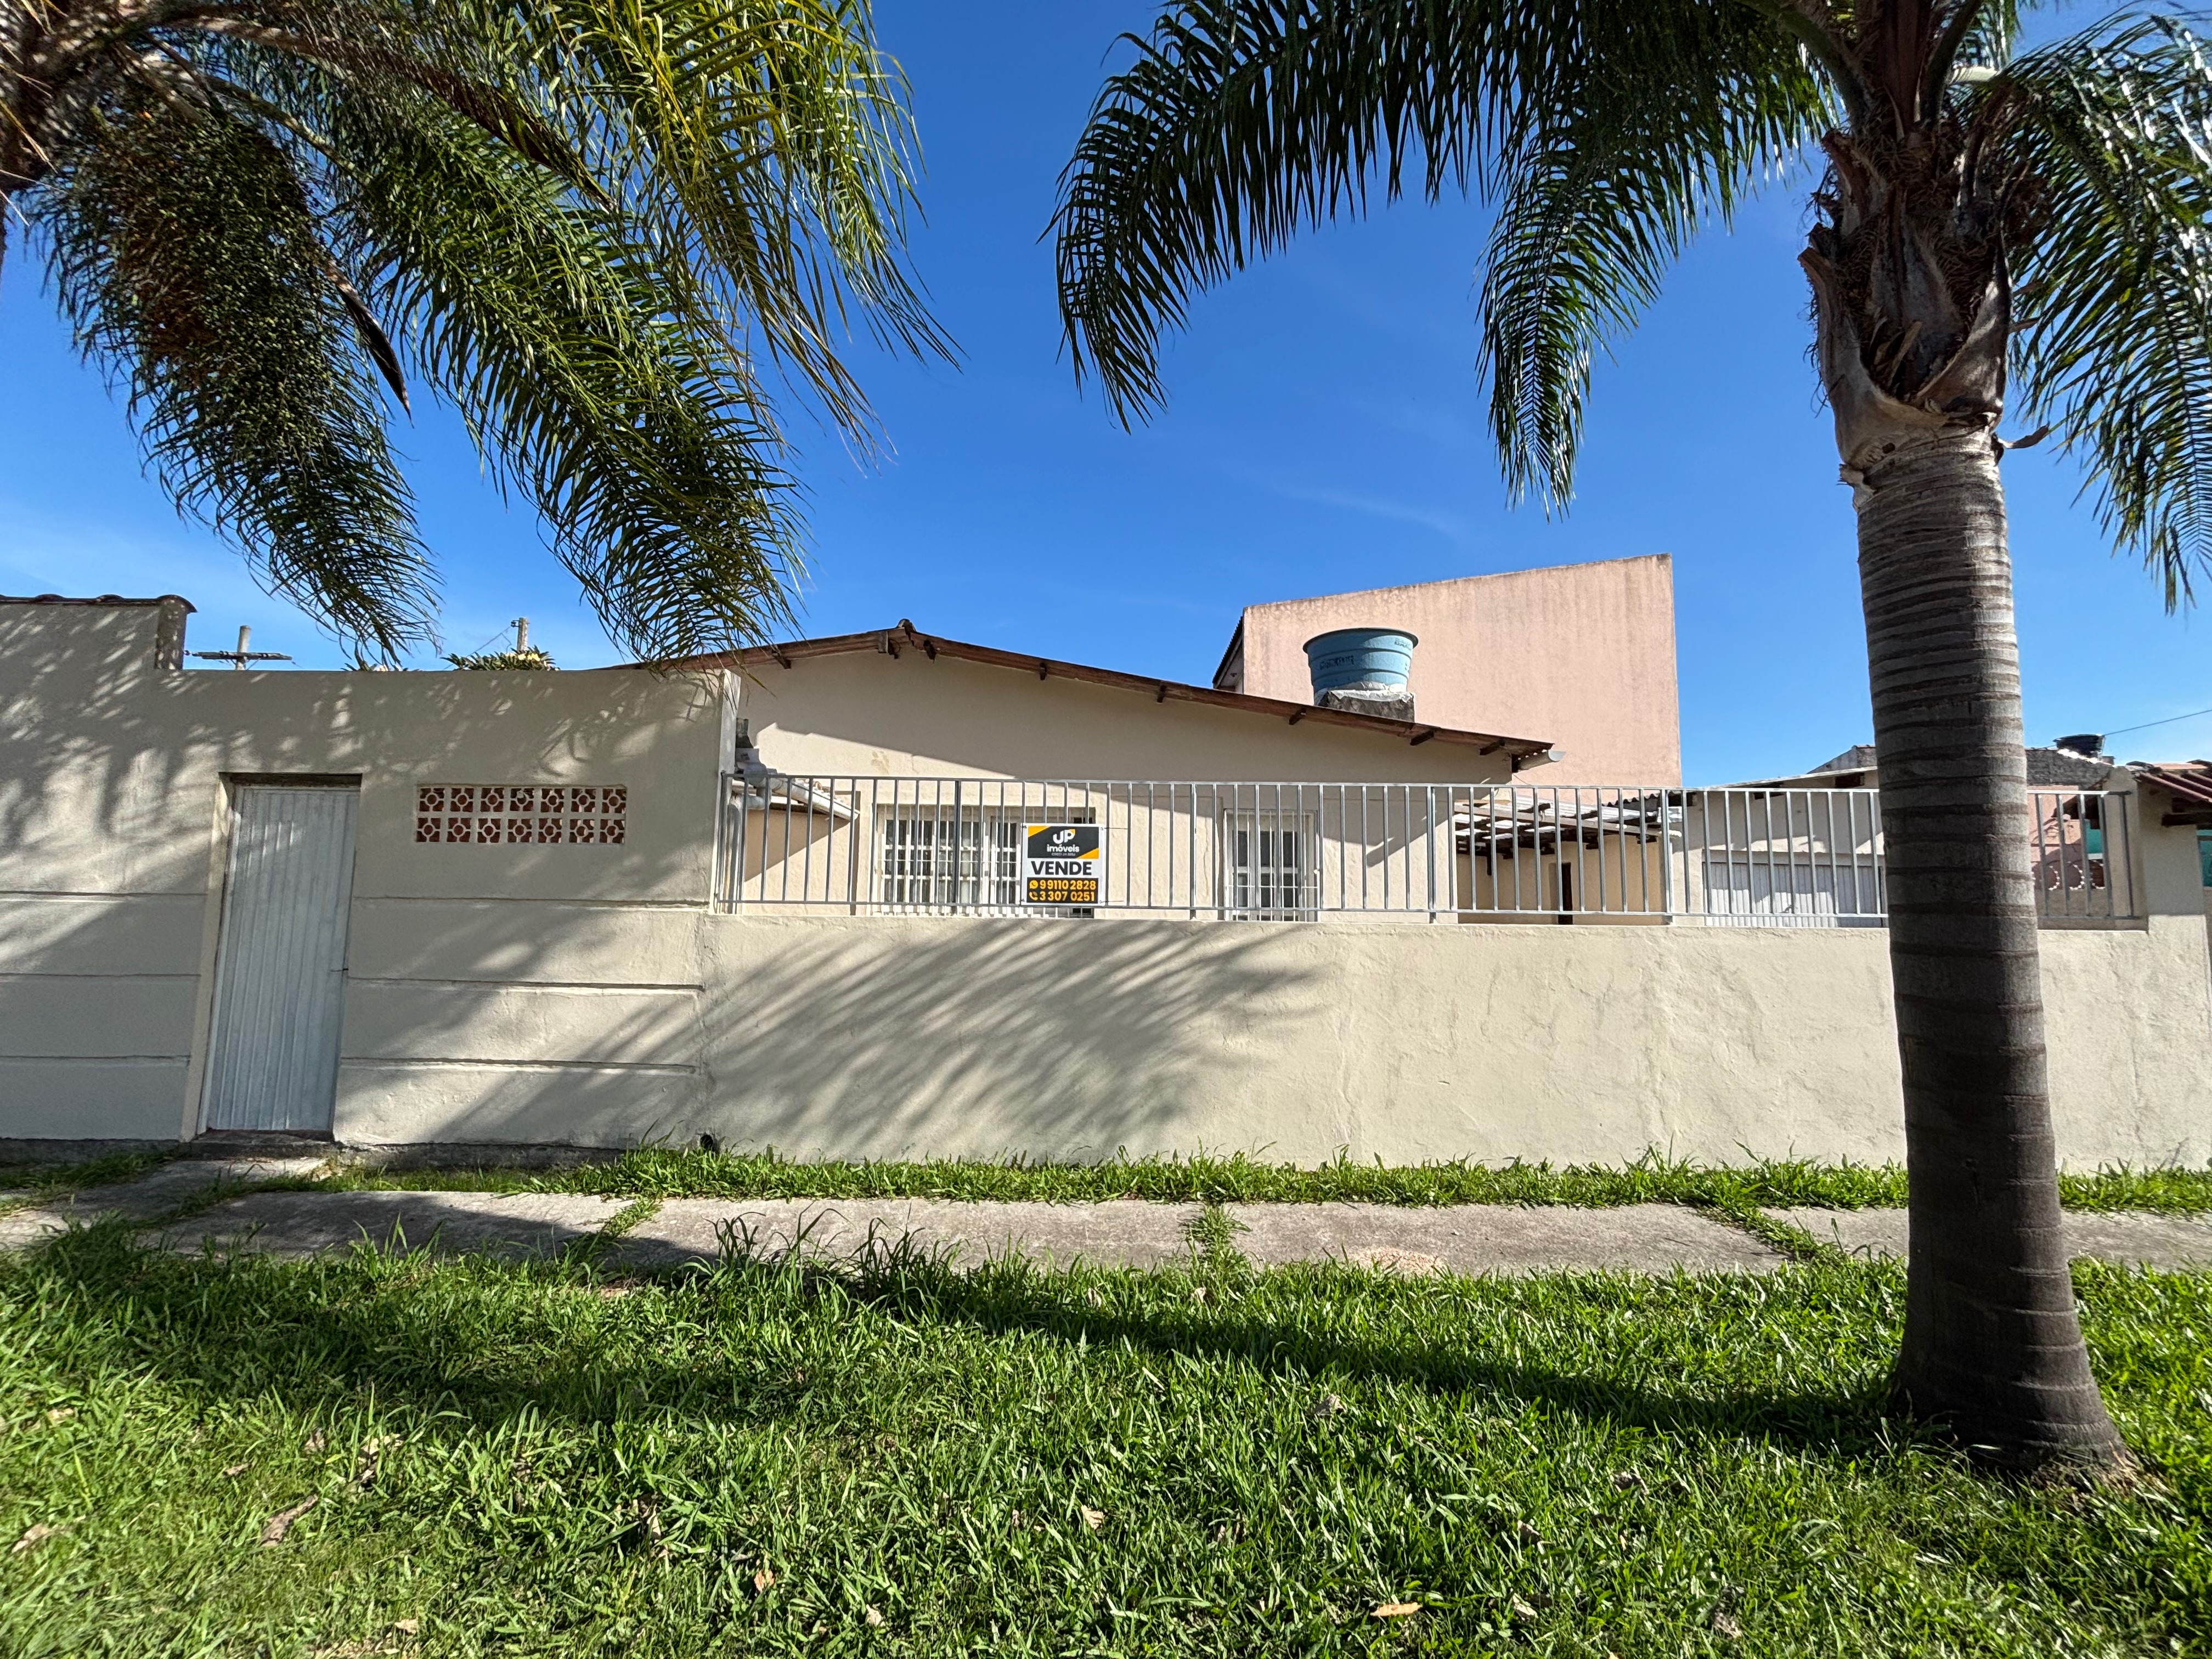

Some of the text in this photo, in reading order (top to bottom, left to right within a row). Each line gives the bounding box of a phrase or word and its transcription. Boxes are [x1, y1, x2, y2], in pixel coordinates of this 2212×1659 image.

[1031, 861, 1091, 875] VENDE
[1070, 881, 1096, 890] 2828
[1070, 891, 1094, 901] 0251
